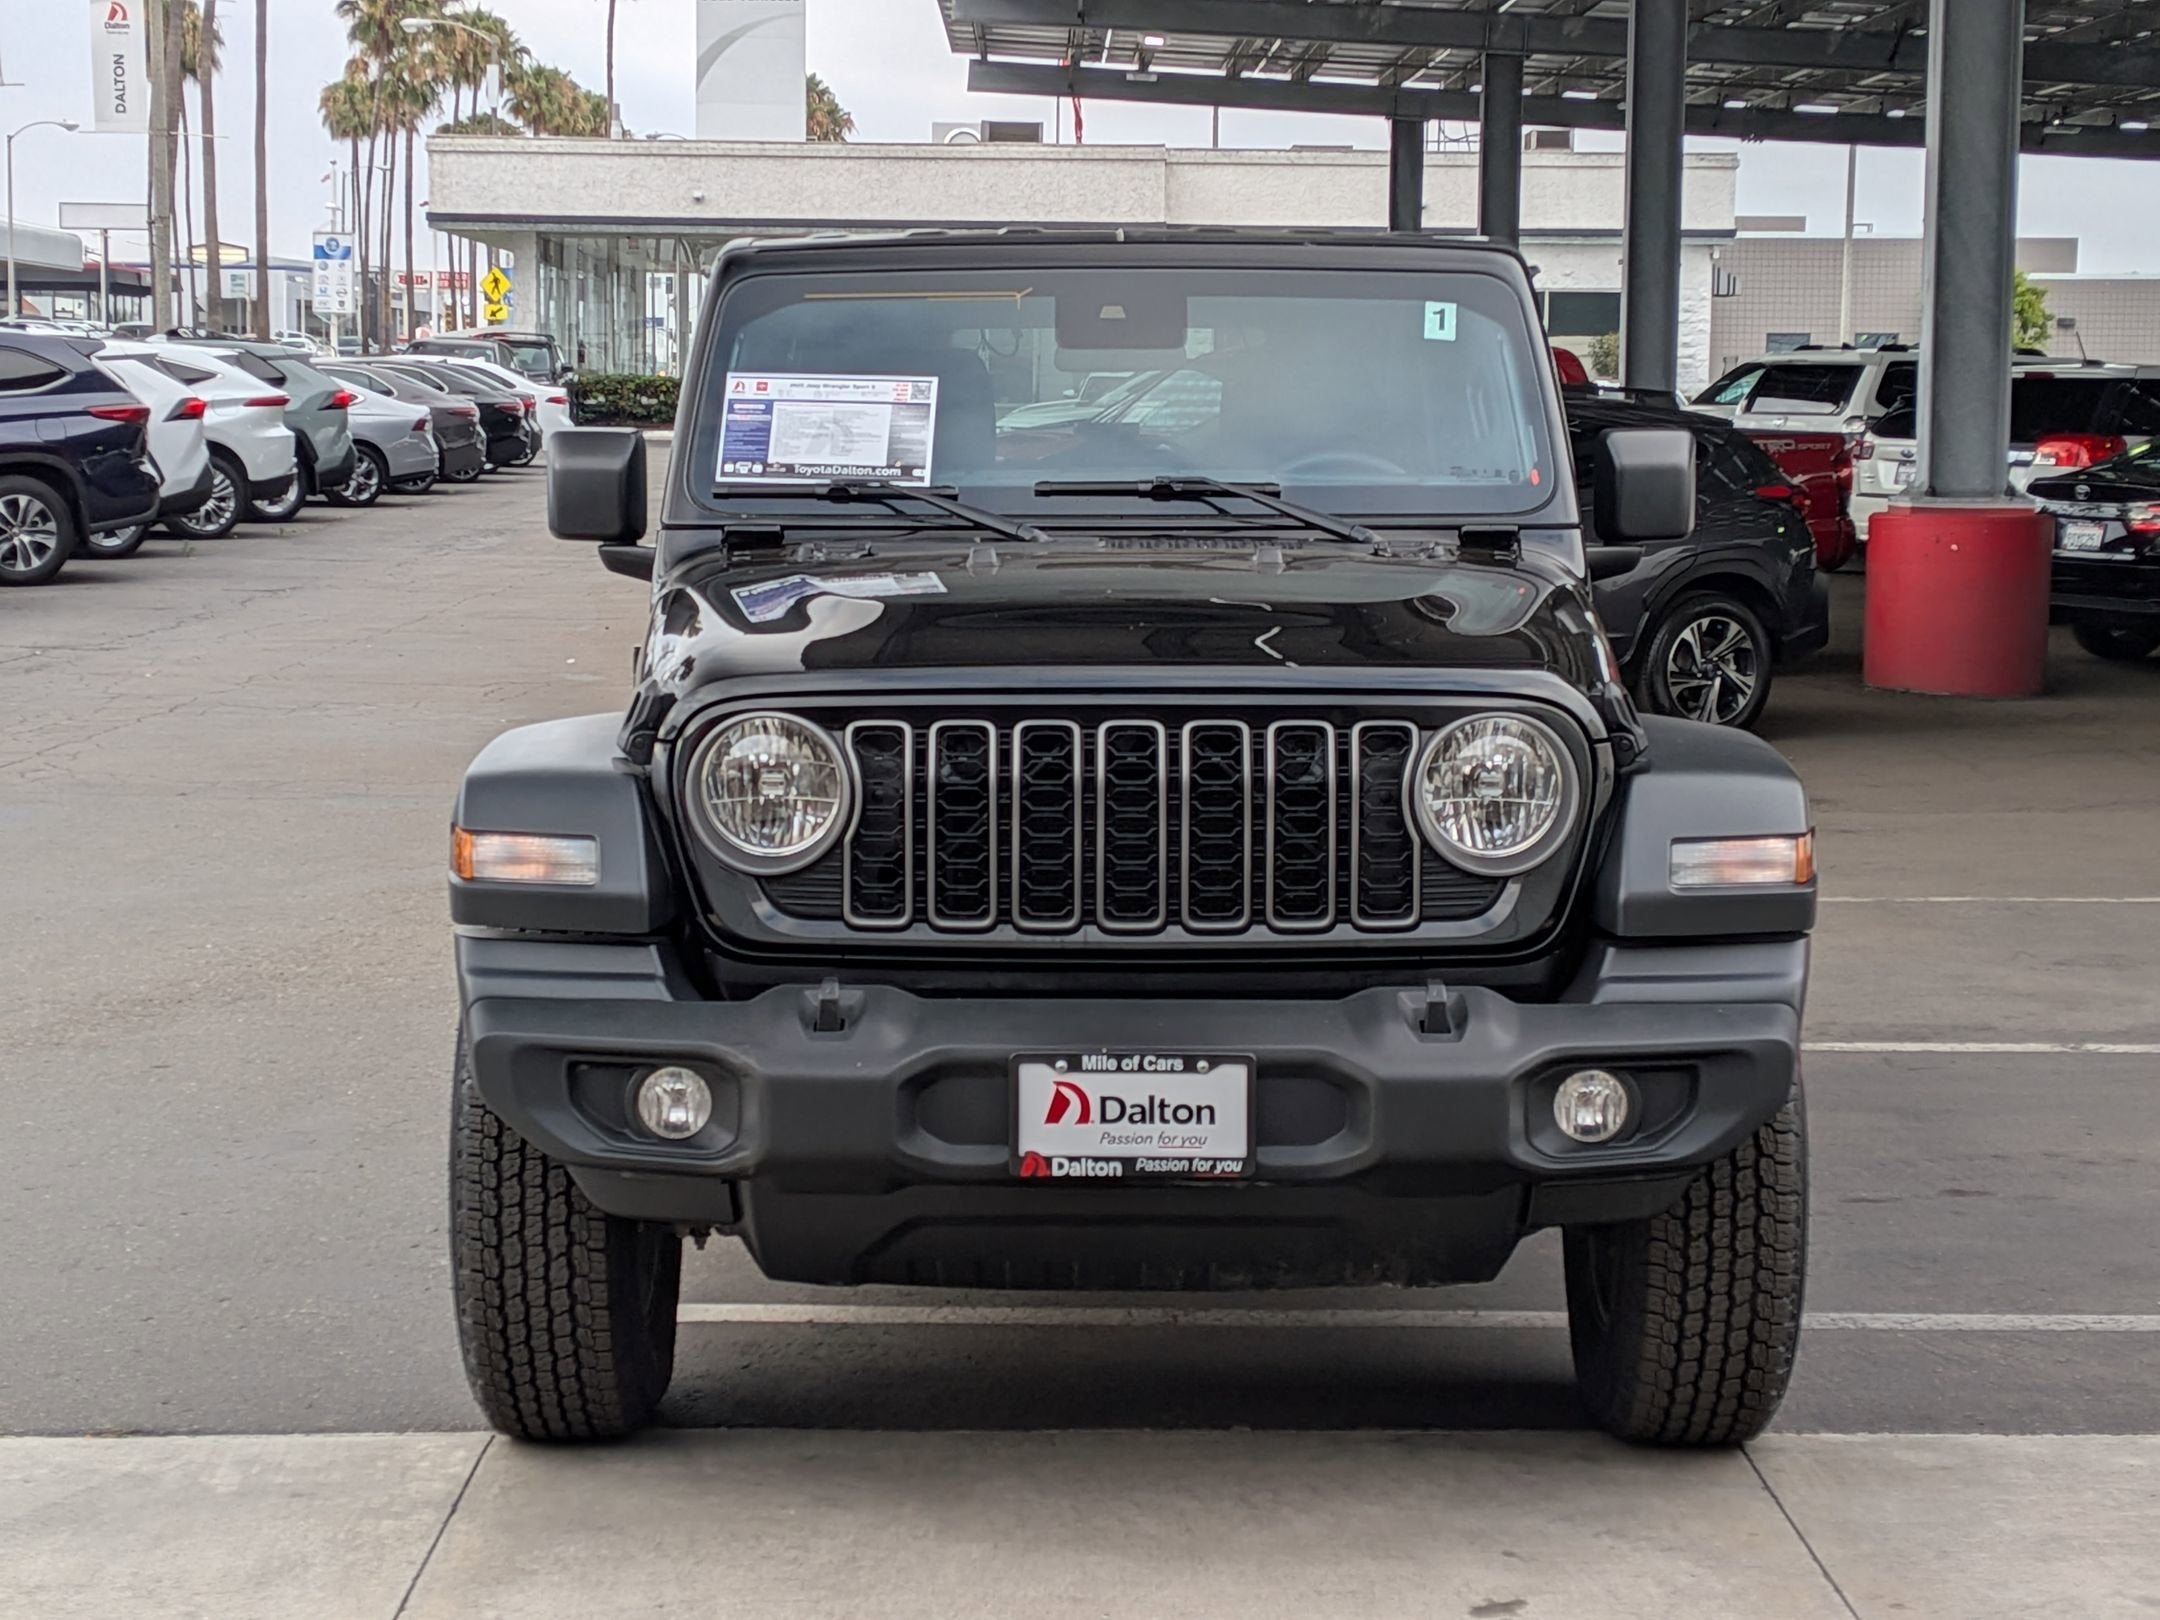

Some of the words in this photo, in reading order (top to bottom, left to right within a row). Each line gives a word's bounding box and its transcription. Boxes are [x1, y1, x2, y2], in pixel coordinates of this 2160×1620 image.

[113, 54, 127, 115] DALTON
[1432, 308, 1446, 331] 1
[793, 463, 902, 477] ToyotaDalton.com
[1081, 1055, 1118, 1072] Mile
[1120, 1054, 1140, 1072] of
[1143, 1055, 1184, 1072] Cars
[1099, 1095, 1216, 1125] Dalton
[1099, 1132, 1153, 1146] Passion
[1157, 1131, 1176, 1147] for
[1180, 1136, 1208, 1148] you
[1051, 1157, 1123, 1177] Dalton
[1135, 1157, 1189, 1172] Passion
[1191, 1157, 1214, 1173] for
[1216, 1161, 1243, 1175] you
